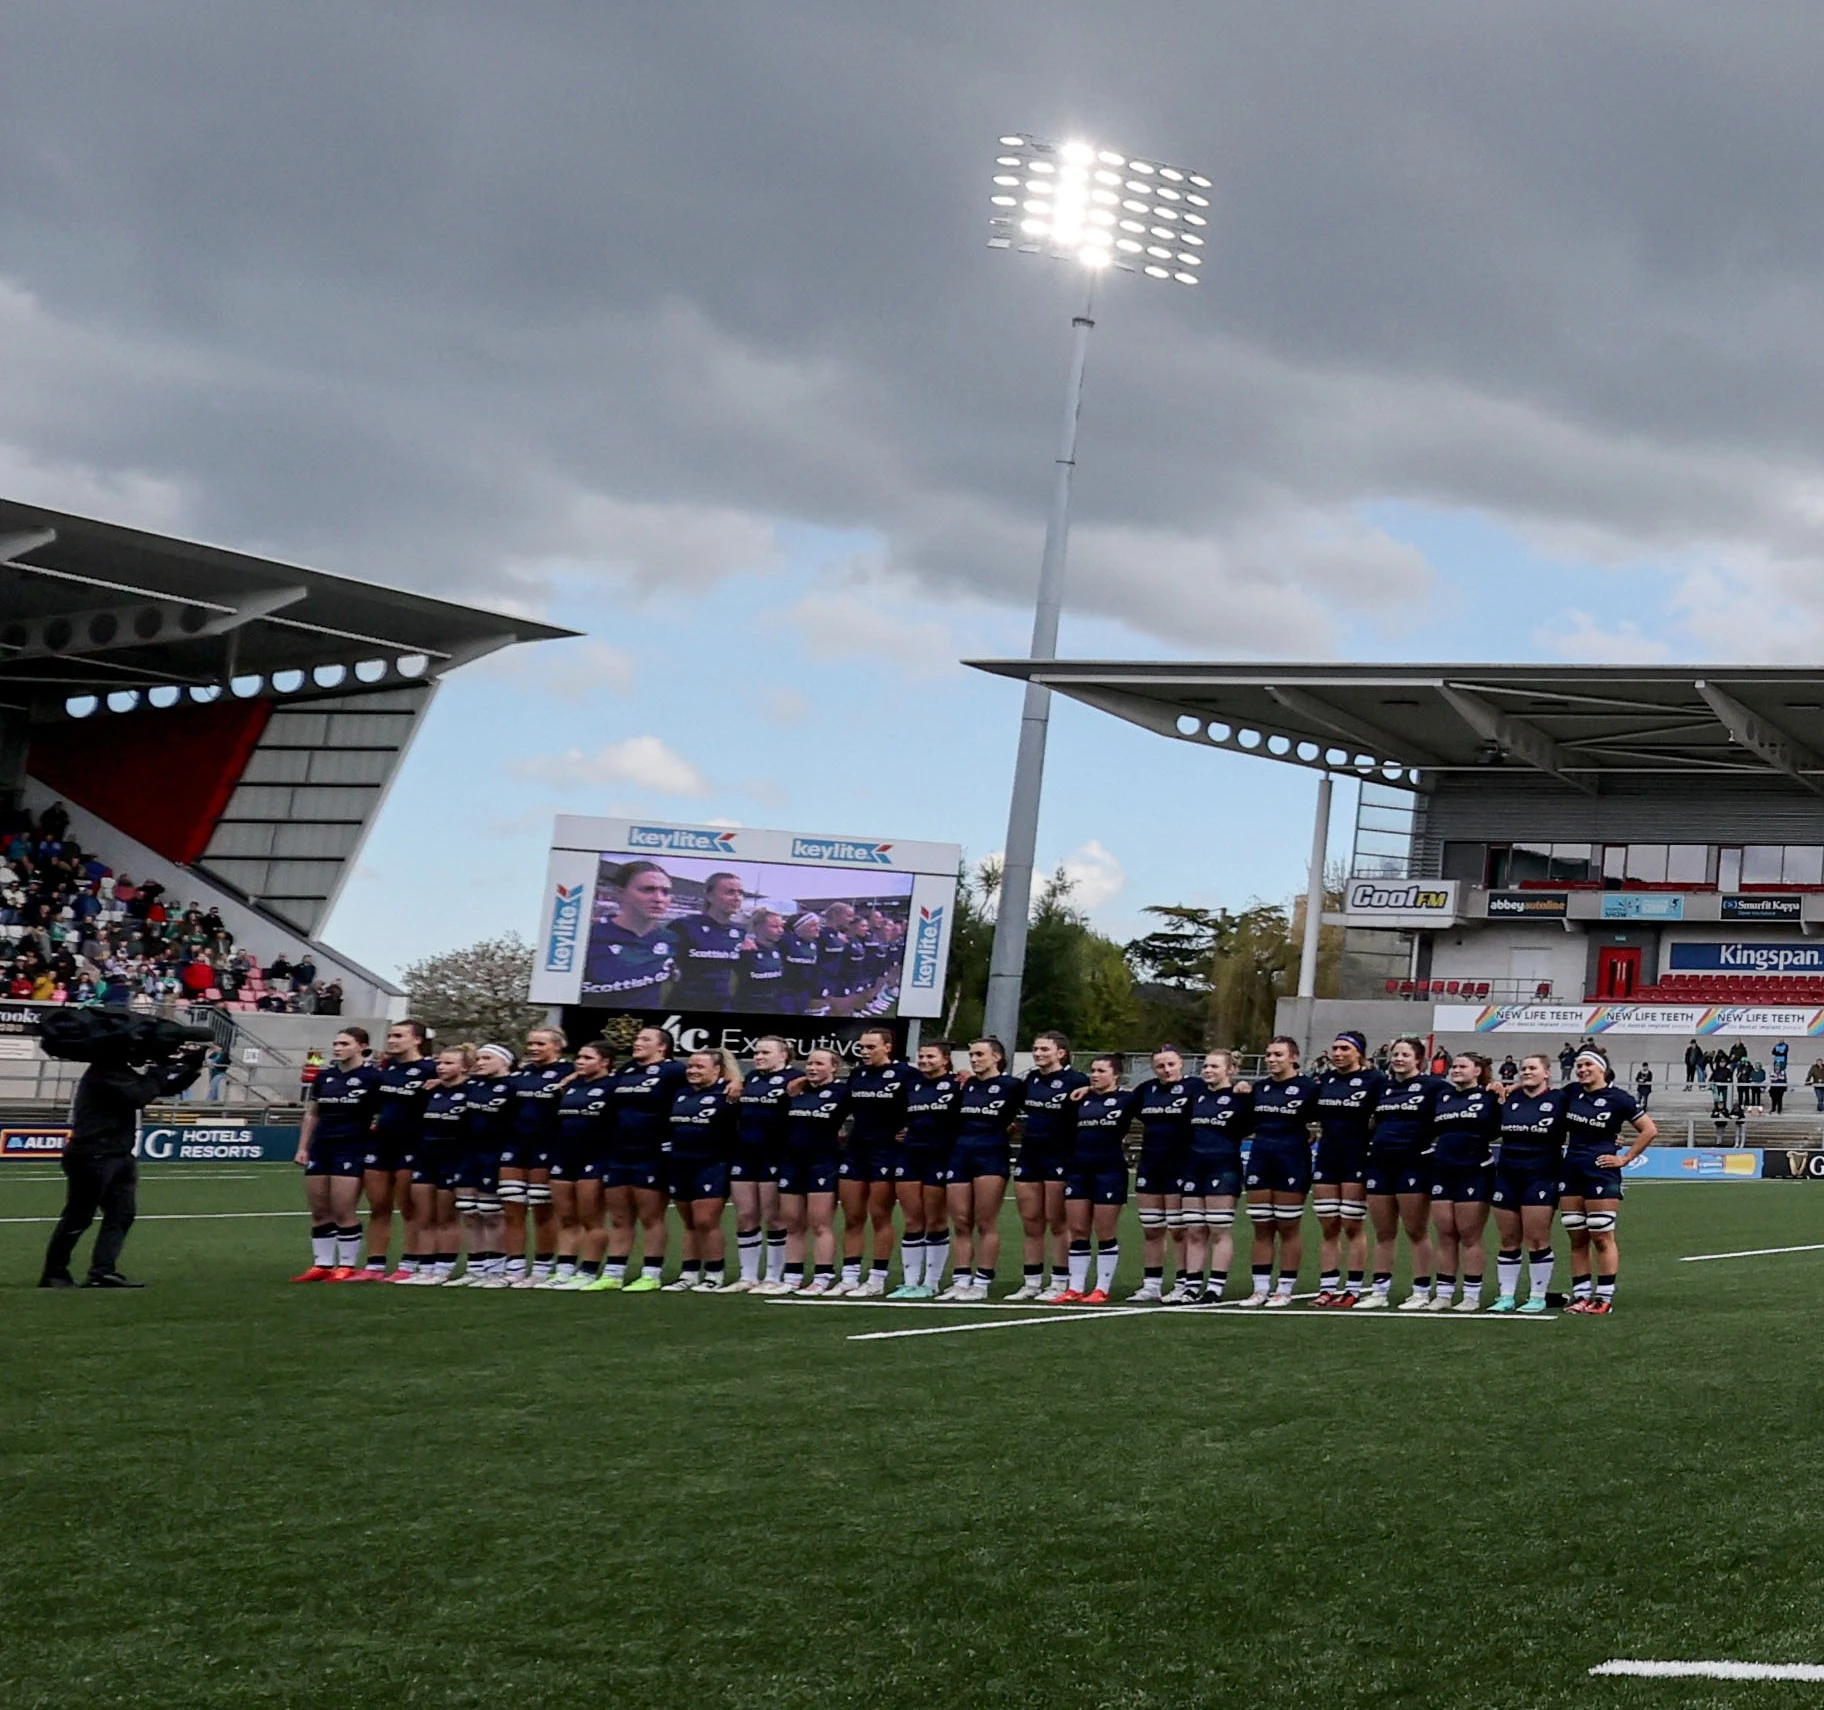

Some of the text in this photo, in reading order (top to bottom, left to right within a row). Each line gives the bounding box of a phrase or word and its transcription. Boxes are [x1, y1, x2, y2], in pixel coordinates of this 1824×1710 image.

[630, 827, 711, 850] keylite
[794, 840, 871, 862] keylite
[1738, 900, 1800, 912] Smurfit Kappa
[548, 904, 577, 972] keylite
[914, 924, 938, 988] keylite
[1720, 945, 1819, 970] Kingspan
[1496, 1011, 1583, 1020] NEW LIFE TEETH
[1606, 1012, 1694, 1021] NEW LIFE TEETH
[1717, 1014, 1805, 1023] NEW LIFE TEETH
[722, 1028, 865, 1058] Exutive
[24, 1135, 65, 1149] ALDI
[183, 1130, 251, 1142] HOTELS
[180, 1146, 262, 1158] RESORTS
